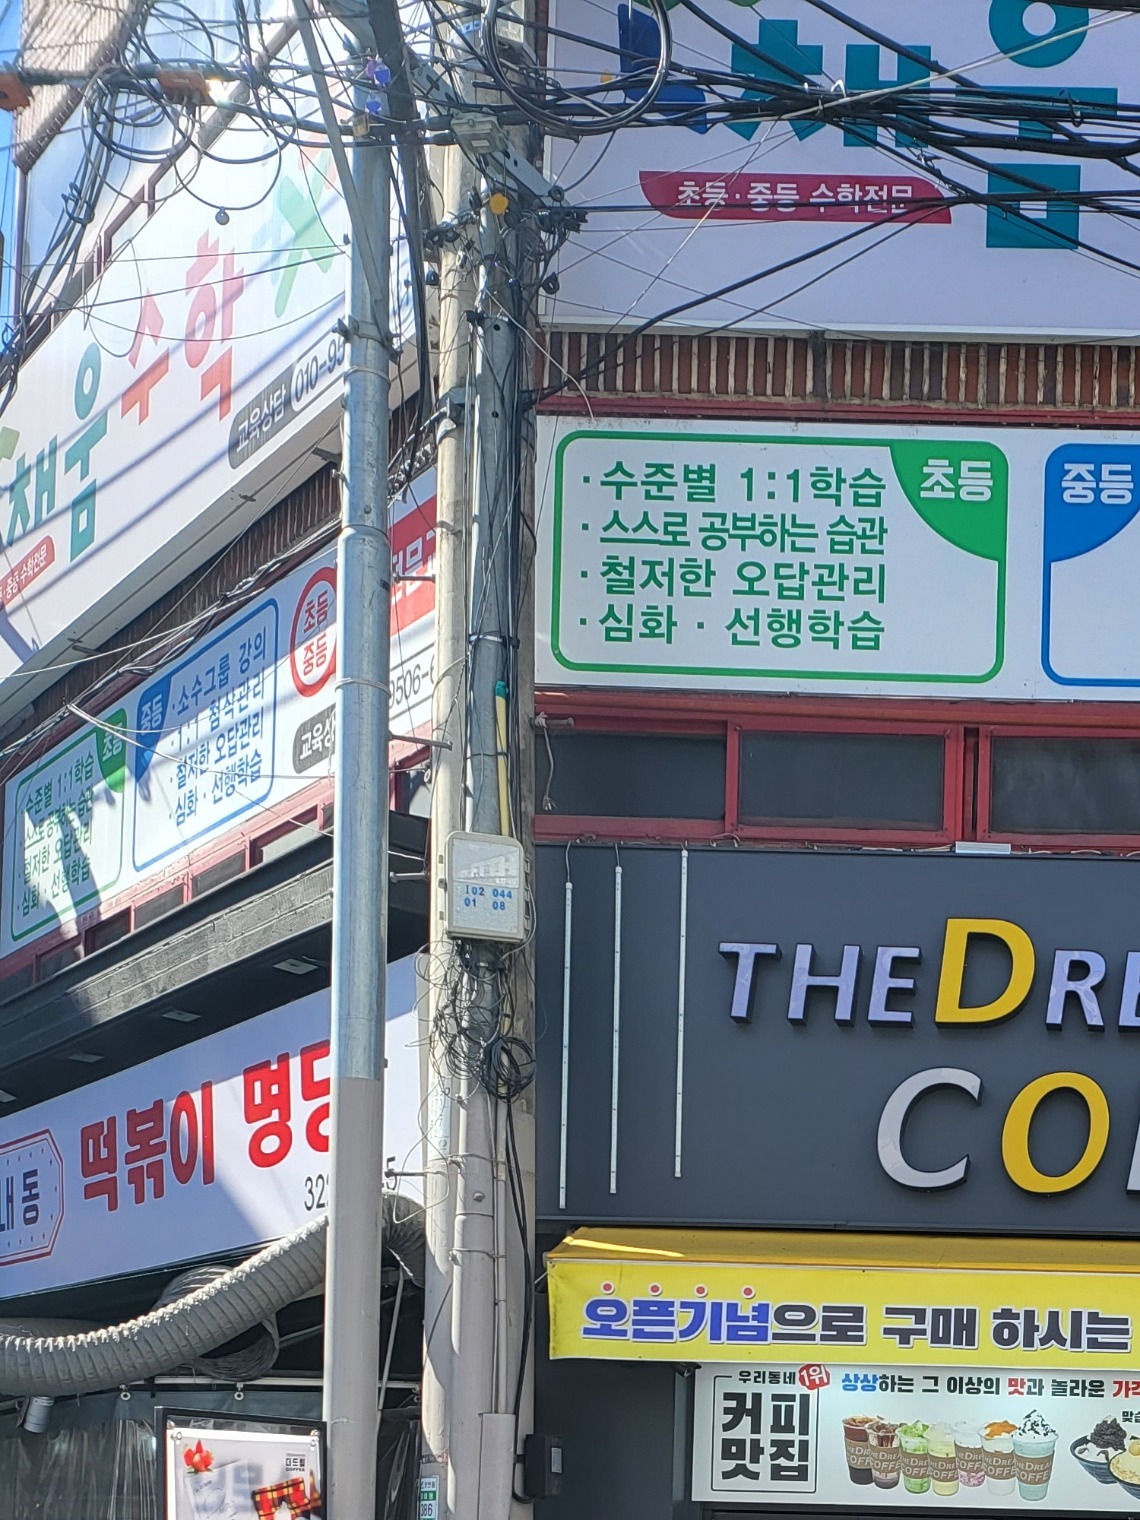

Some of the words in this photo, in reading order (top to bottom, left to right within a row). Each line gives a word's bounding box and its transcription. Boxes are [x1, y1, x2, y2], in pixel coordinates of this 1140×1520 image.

[236, 382, 288, 453] 교육상담
[600, 460, 717, 503] 수준별
[740, 466, 887, 508] 1:1학습
[919, 458, 995, 502] 초등
[1060, 462, 1135, 505] 중등
[599, 510, 691, 547] 스스로
[698, 511, 819, 553] 공부하는
[826, 515, 888, 556] 습관
[600, 555, 717, 598] 철저한
[731, 560, 887, 604] 오답관리
[303, 589, 328, 634] 초등
[599, 602, 679, 644] 심화
[724, 606, 886, 651] 선행학습
[177, 653, 231, 716] 소수그룹
[238, 625, 267, 675] 강의
[303, 632, 327, 676] 중등
[140, 693, 163, 736] 중등
[208, 666, 265, 732] 첨삭관리
[176, 740, 210, 790] 철저한
[214, 705, 264, 765] 오답관리
[175, 784, 197, 827] 심화
[212, 747, 263, 805] 선행학습
[22, 881, 40, 917] 심화
[492, 887, 513, 899] 044
[492, 900, 506, 911] 08
[79, 1079, 216, 1213] 떡볶이
[581, 1296, 868, 1347] 오픈기념으로
[882, 1302, 979, 1349] 구매
[992, 1306, 1132, 1352] 하시는
[737, 1369, 796, 1385] 우리동네
[799, 1364, 829, 1387] 1위
[841, 1372, 915, 1394] 상상하는
[921, 1375, 939, 1394] 그
[946, 1374, 1001, 1396] 이상의
[1007, 1376, 1045, 1398] 맛과
[1050, 1378, 1107, 1399] 놀라운
[721, 1392, 811, 1437] 커피
[721, 1438, 810, 1482] 맛집
